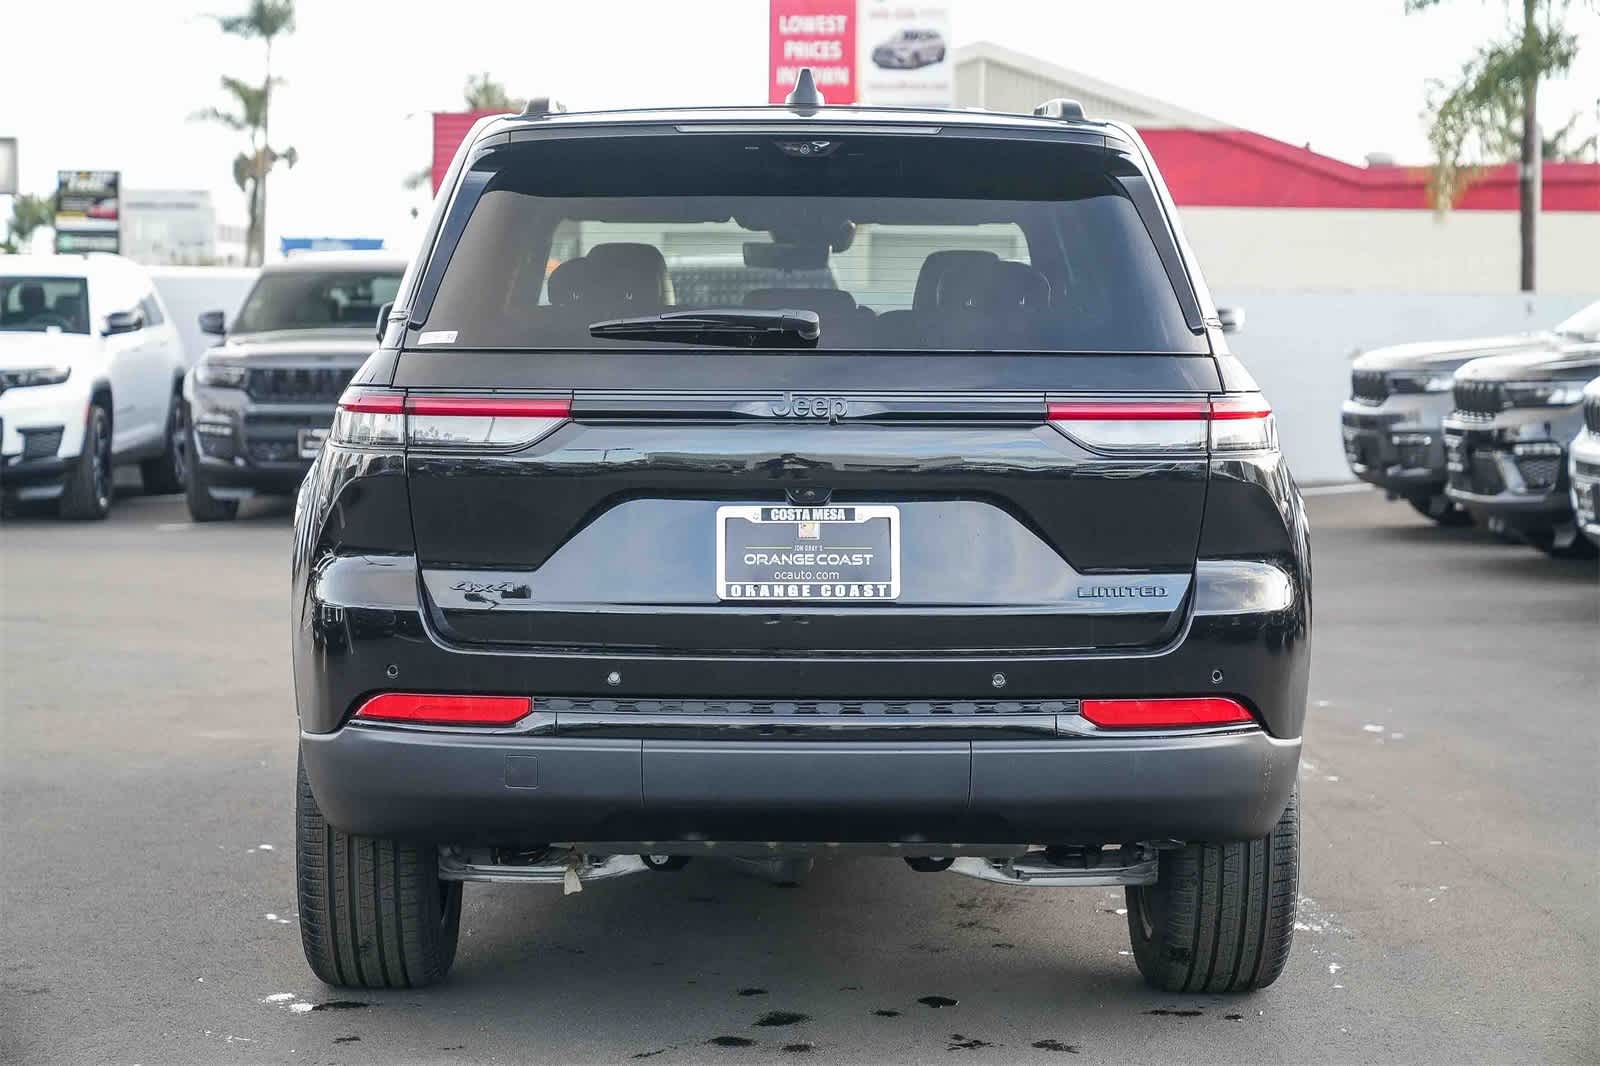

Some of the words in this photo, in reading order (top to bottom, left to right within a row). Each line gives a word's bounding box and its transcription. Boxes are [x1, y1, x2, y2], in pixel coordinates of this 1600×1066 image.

[779, 14, 848, 34] LOWEST
[783, 40, 843, 60] PRICES
[809, 66, 849, 85] OWN
[771, 391, 848, 425] Jeep
[770, 507, 810, 521] COSTA
[812, 507, 846, 521] MESA
[774, 569, 840, 581] ocauto.com
[730, 583, 811, 598] ORANGE
[820, 583, 888, 598] COAST
[1077, 585, 1169, 598] LIMITED
